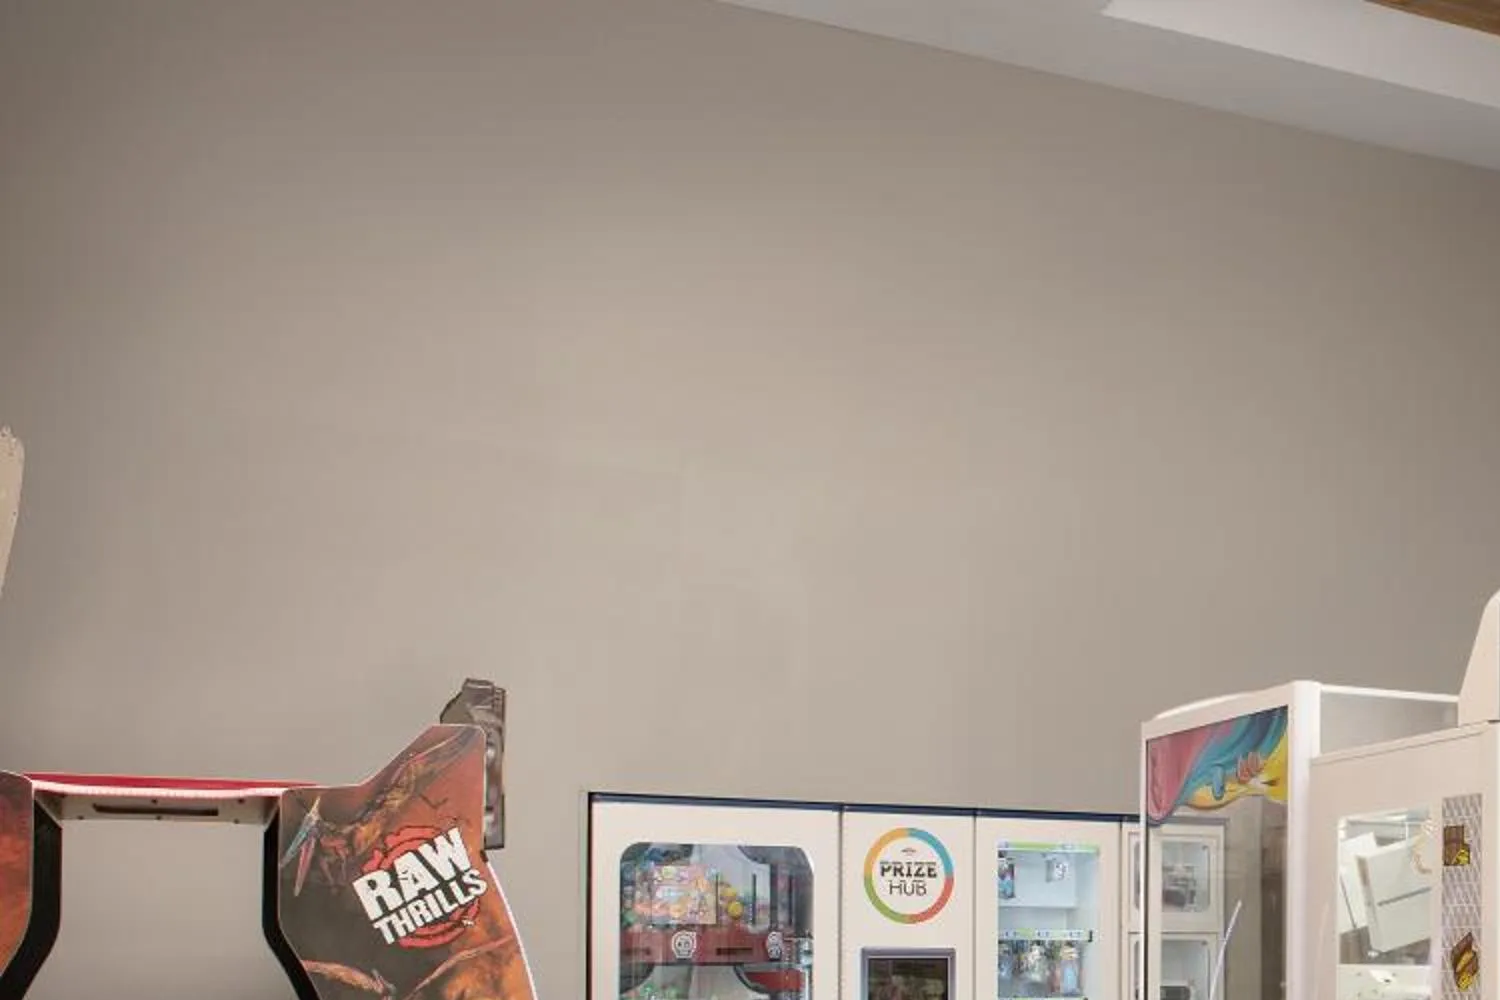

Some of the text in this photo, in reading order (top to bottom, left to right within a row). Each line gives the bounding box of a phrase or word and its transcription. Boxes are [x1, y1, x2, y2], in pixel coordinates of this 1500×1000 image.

[352, 827, 471, 920] RAW
[879, 861, 937, 878] PRIZE
[888, 879, 927, 896] HUB
[372, 868, 487, 945] THRILLS
